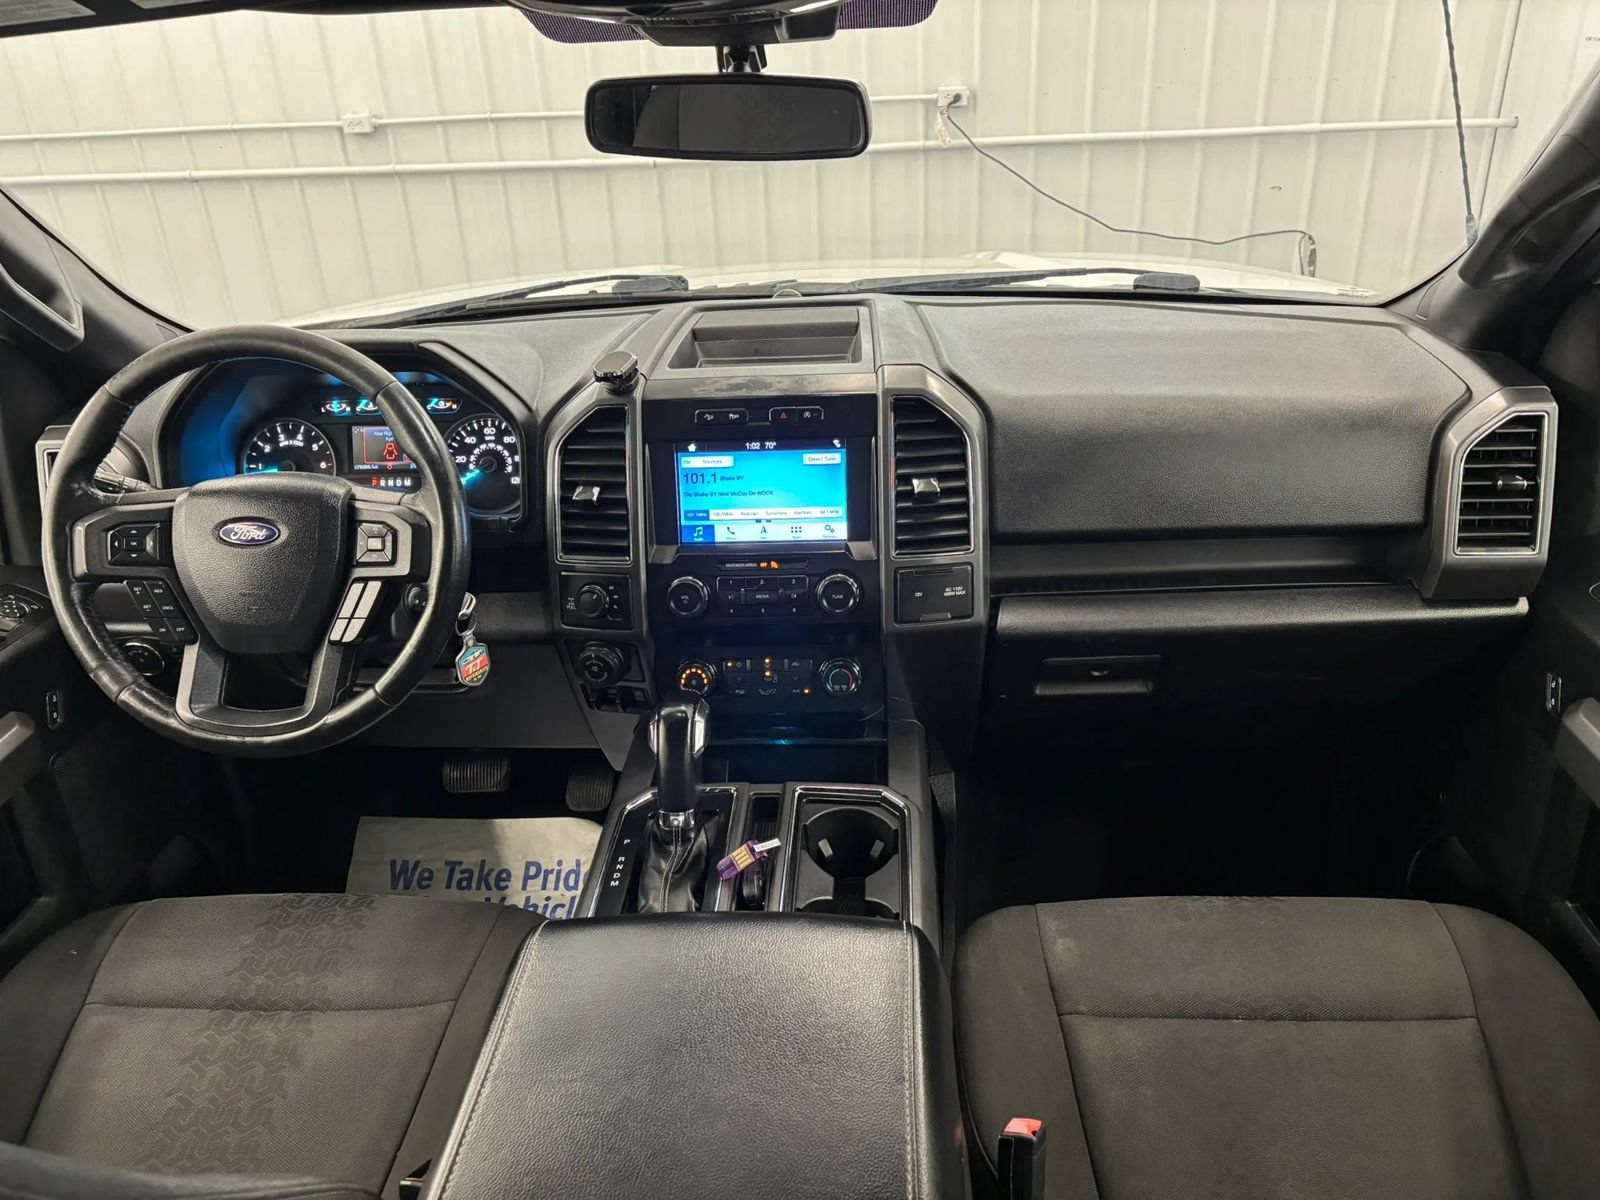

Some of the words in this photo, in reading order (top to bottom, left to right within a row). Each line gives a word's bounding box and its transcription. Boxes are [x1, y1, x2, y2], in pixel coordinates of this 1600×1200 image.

[483, 427, 496, 435] 60
[278, 433, 285, 441] 3
[464, 436, 477, 444] 40
[503, 436, 516, 444] 80
[264, 444, 271, 453] 2
[311, 443, 319, 451] 5
[745, 442, 760, 450] 1:02
[455, 455, 467, 463] 20
[320, 461, 327, 469] 6
[683, 472, 717, 485] 101.1
[230, 524, 267, 540] Ford
[389, 859, 434, 891] We
[444, 859, 512, 891] Take
